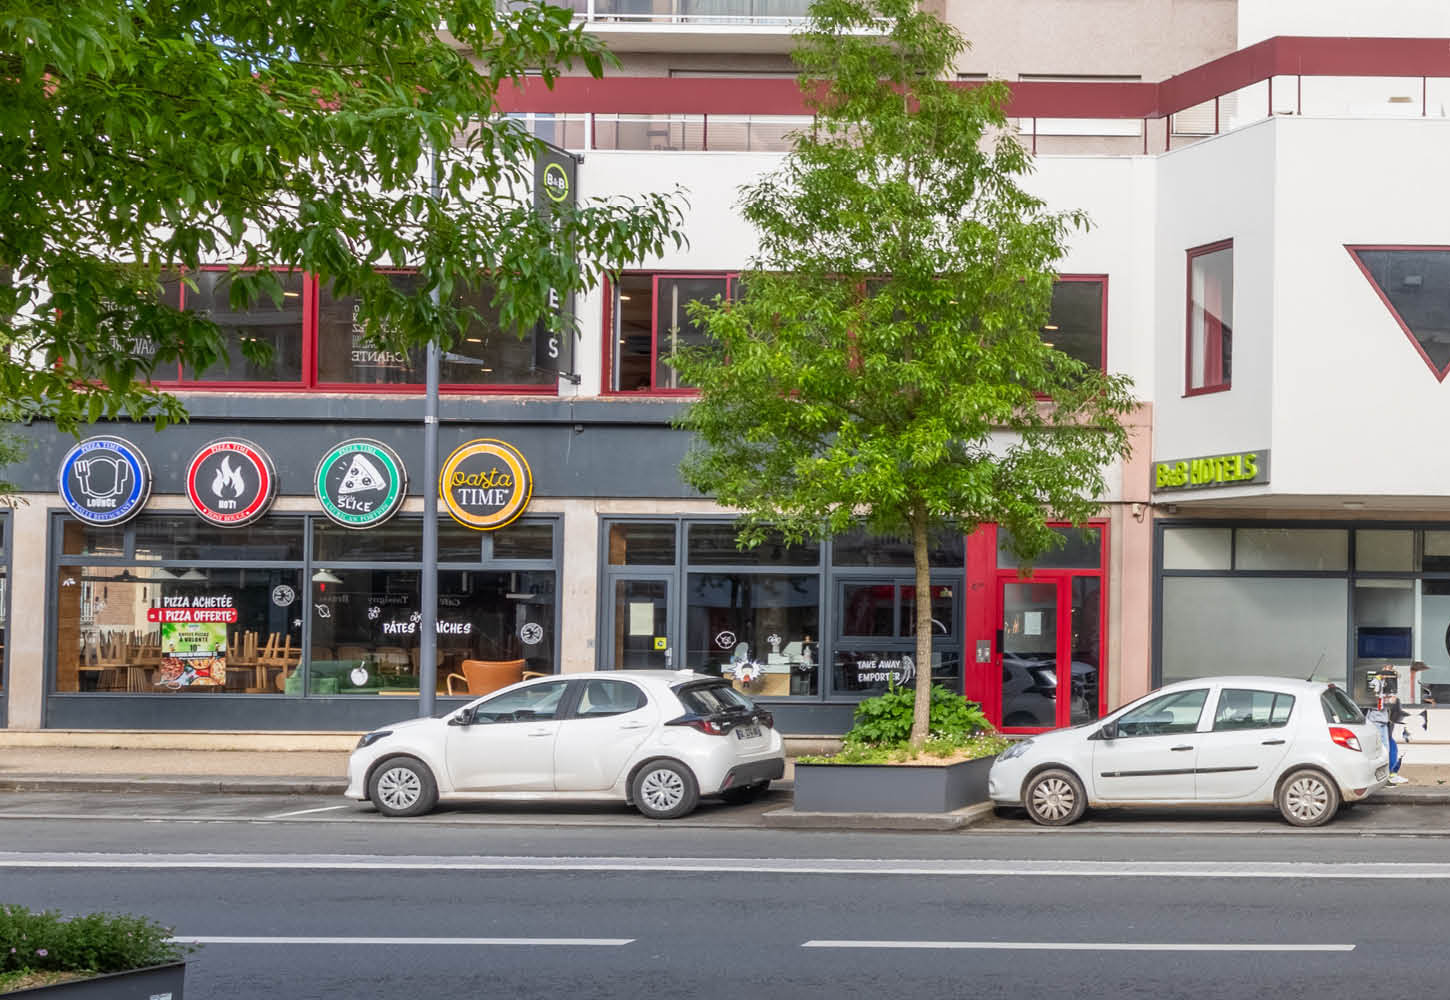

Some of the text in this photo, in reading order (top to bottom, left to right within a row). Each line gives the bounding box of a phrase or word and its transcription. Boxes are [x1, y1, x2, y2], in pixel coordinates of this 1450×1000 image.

[1190, 453, 1258, 485] HOTELS
[337, 498, 374, 512] SLICE
[163, 595, 190, 608] PIZZA
[191, 594, 233, 608] ACHETÉE
[165, 610, 191, 622] PIZZA
[384, 620, 415, 634] PÂTES
[857, 660, 901, 669] TAKE AWAY
